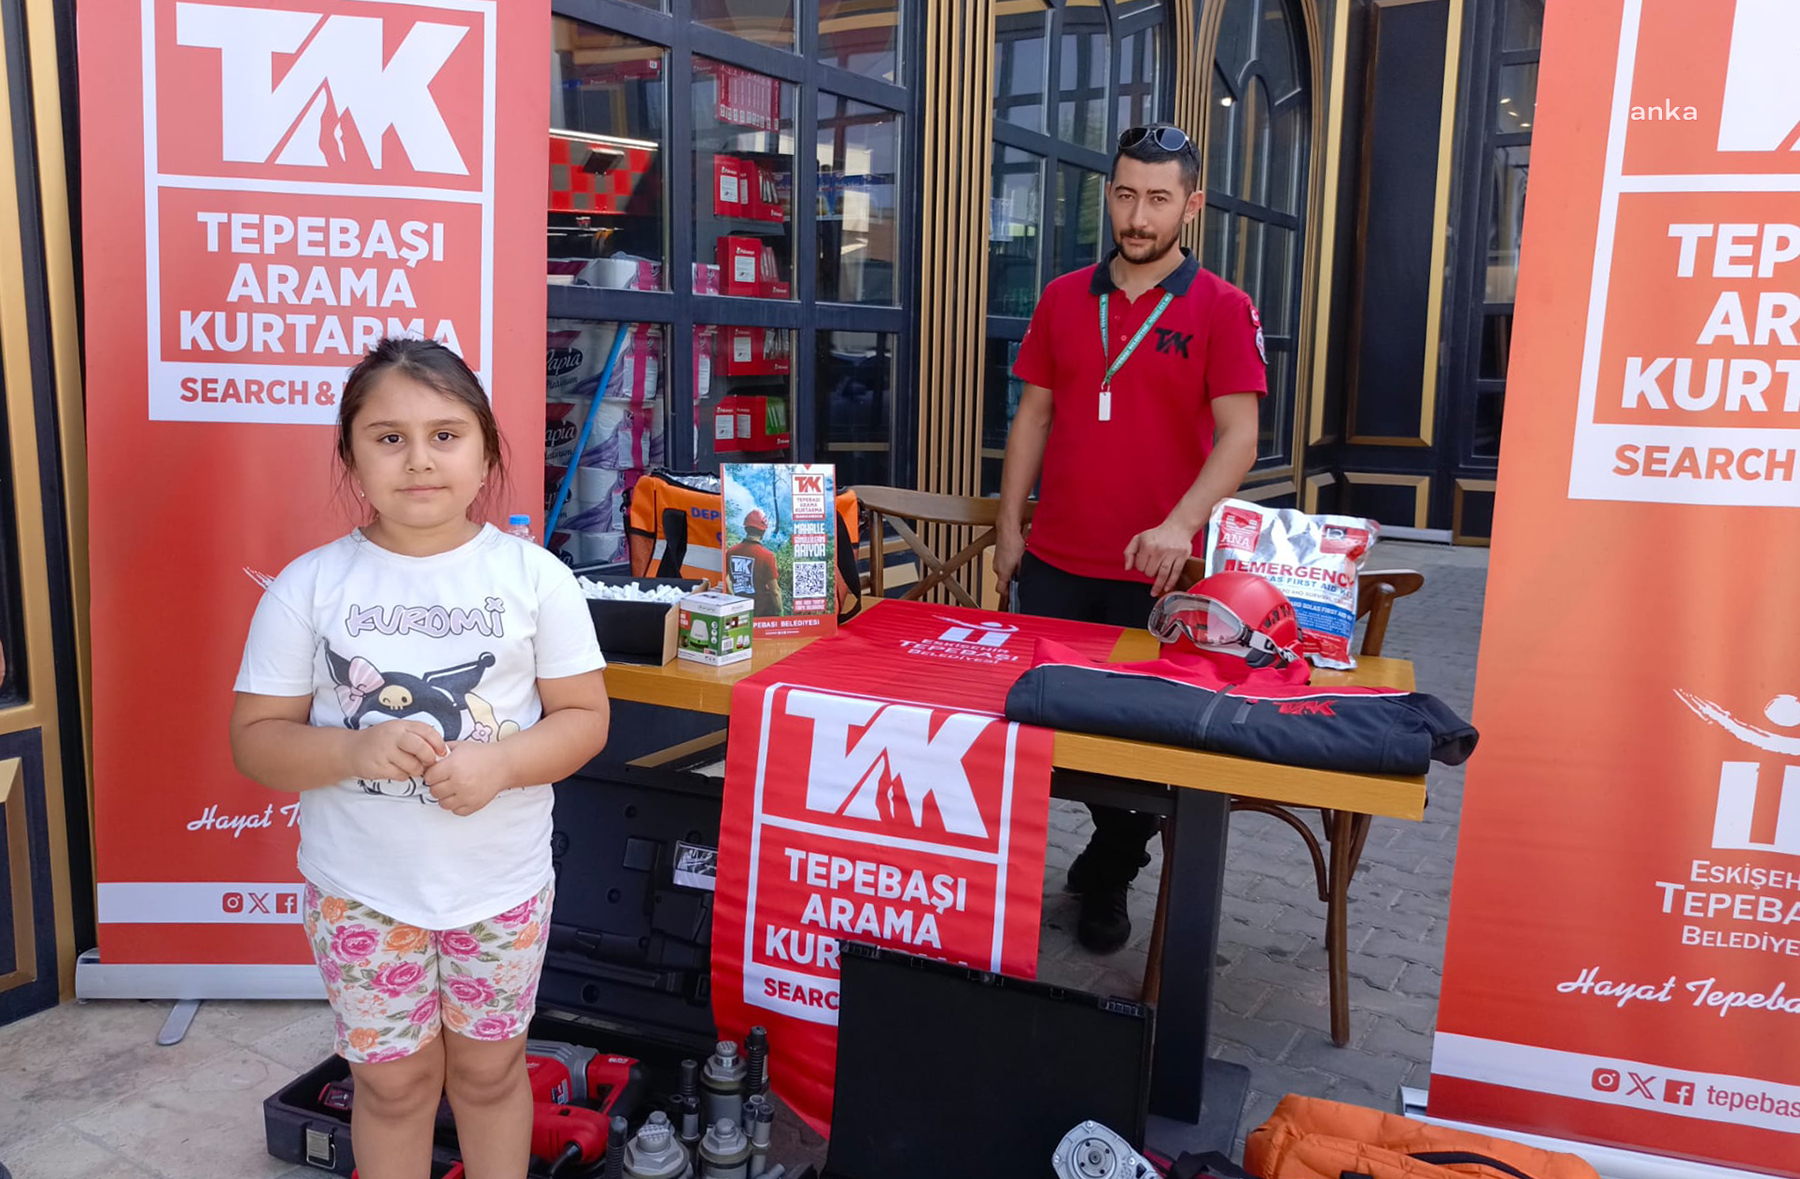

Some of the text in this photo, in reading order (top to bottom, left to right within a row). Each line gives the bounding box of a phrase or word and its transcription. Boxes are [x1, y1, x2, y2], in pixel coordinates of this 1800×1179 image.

[176, 2, 471, 176] TAK
[197, 211, 445, 269] TEPEBAŞI
[226, 262, 417, 309] ARAMA
[1155, 327, 1194, 359] TAK
[180, 377, 309, 405] SEARCH
[315, 381, 336, 406] &
[545, 420, 575, 446] apia
[1612, 444, 1796, 482] SEARCH
[795, 476, 821, 493] TAK
[691, 506, 721, 521] DEP
[794, 523, 826, 535] MAHALLE
[1221, 532, 1251, 548] ANA
[785, 689, 997, 839] TAK
[187, 803, 273, 838] Hayat
[785, 847, 966, 915] TEPEBAŞI
[801, 893, 942, 949] ARAMA
[765, 924, 841, 969] KUR
[764, 977, 840, 1011] SEARC
[1556, 966, 1677, 1008] Hayat
